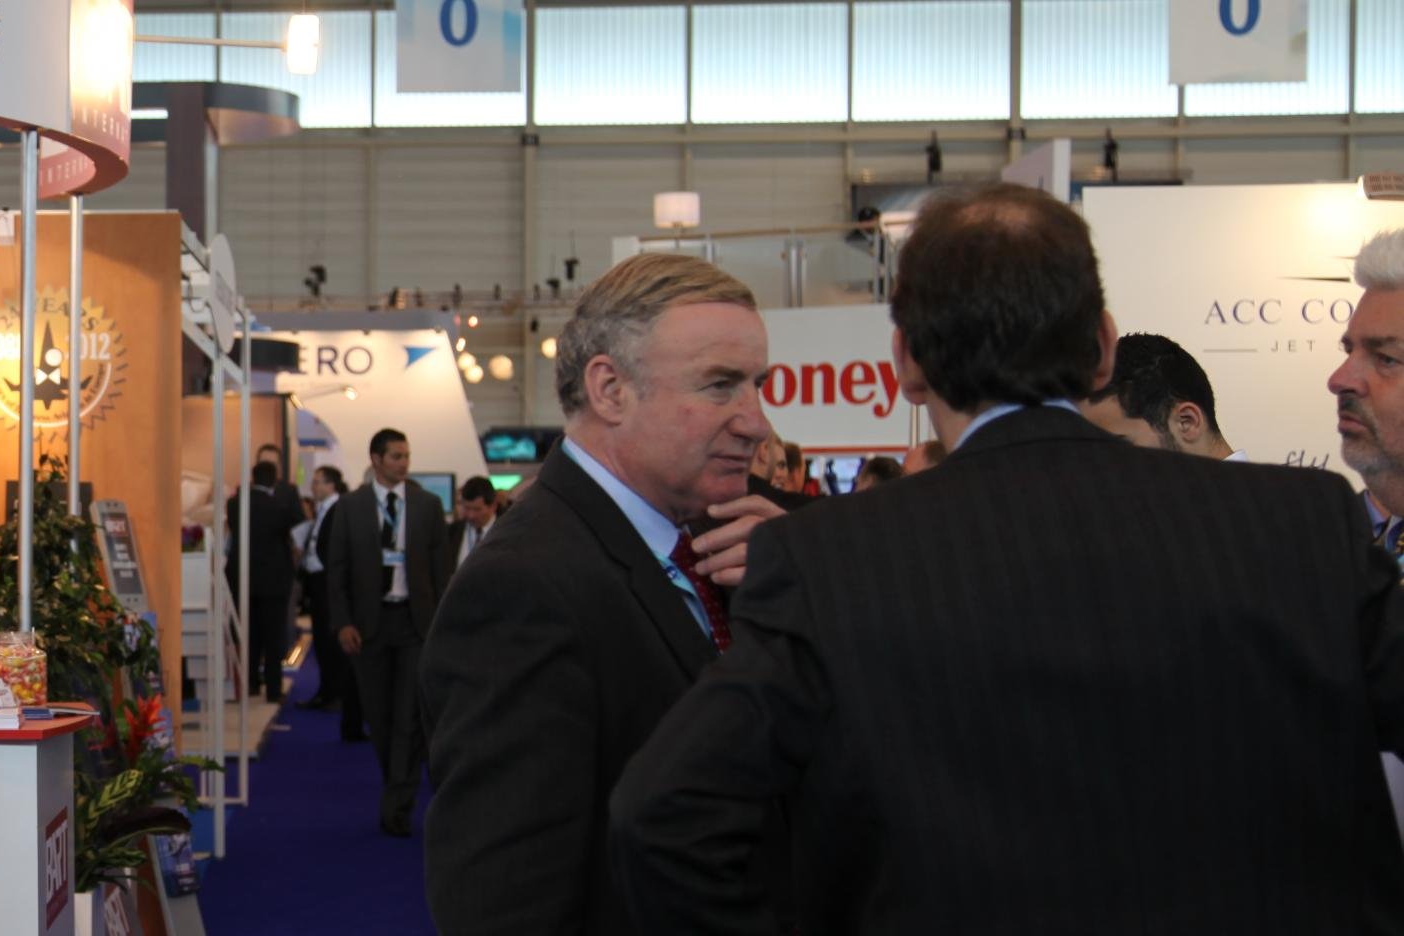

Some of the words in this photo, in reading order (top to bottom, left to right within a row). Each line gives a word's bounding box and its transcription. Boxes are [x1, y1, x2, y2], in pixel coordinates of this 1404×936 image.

[1204, 298, 1283, 325] ACC
[1301, 298, 1355, 325] CO
[1270, 339, 1316, 353] JET
[762, 359, 901, 419] oney
